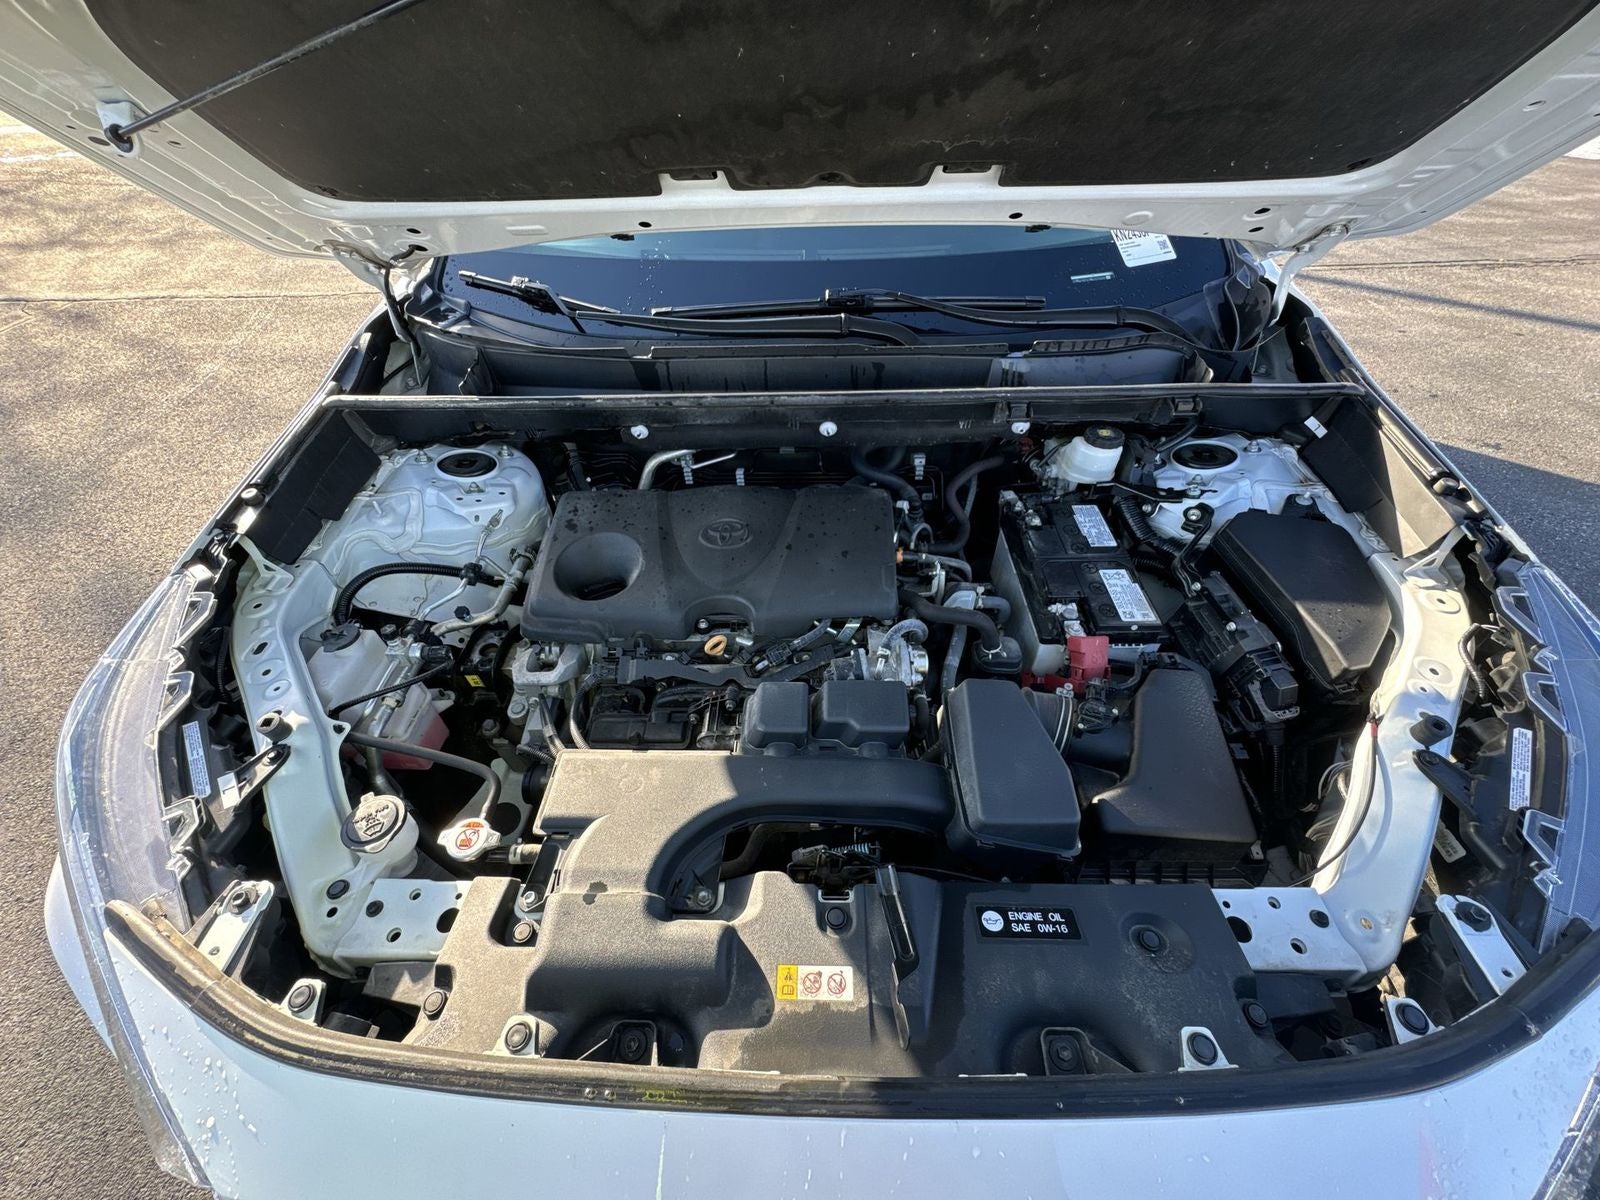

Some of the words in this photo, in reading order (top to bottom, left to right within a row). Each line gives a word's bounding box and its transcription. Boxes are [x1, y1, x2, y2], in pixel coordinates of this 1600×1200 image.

[1008, 911, 1043, 921] ENGINE
[1048, 912, 1066, 922] OIL
[1011, 923, 1032, 932] SAE
[1037, 923, 1069, 933] 0W-16
